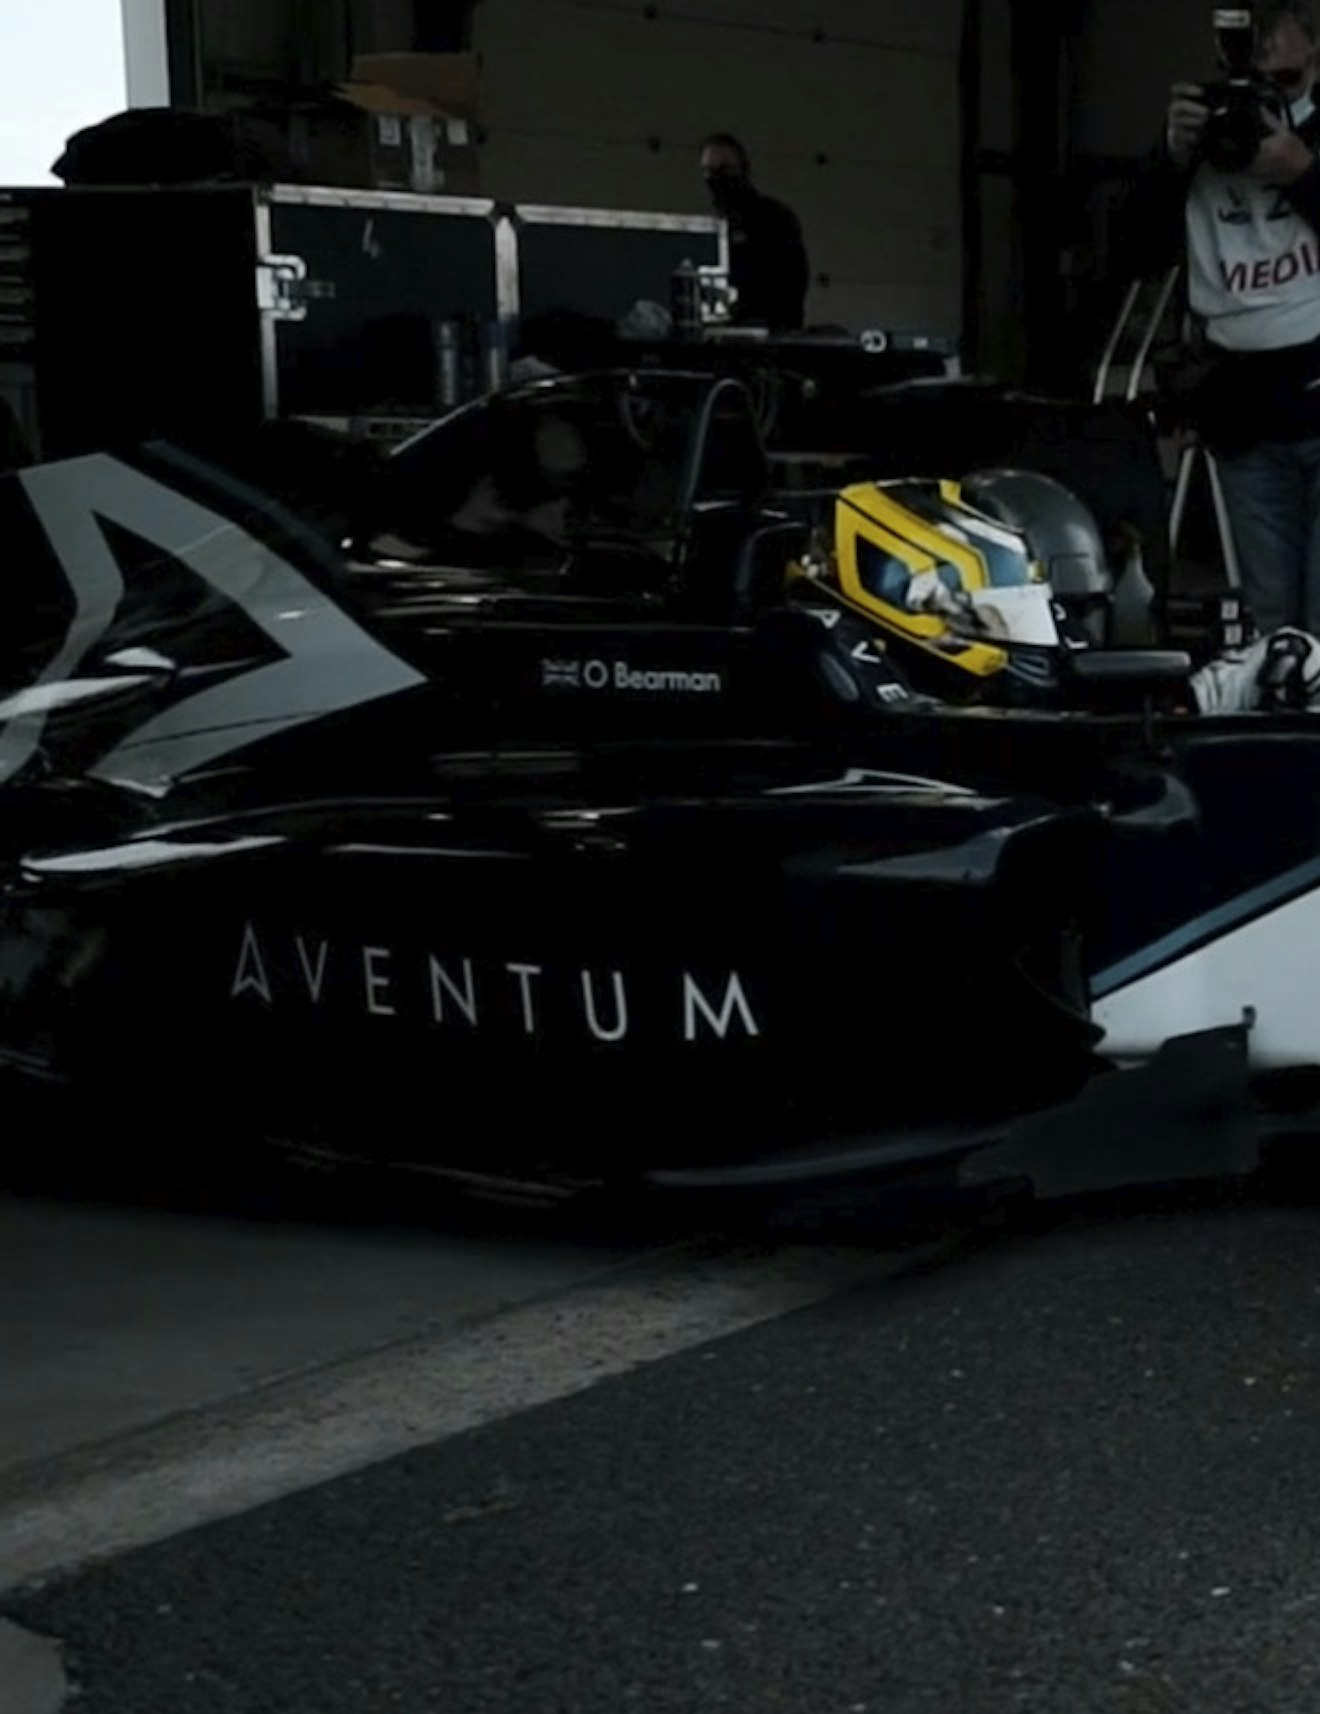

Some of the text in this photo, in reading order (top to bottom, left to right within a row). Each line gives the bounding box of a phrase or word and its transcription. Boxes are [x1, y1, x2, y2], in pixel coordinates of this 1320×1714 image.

[583, 658, 721, 692] O Bearman
[228, 917, 760, 1042] AVENTUM
